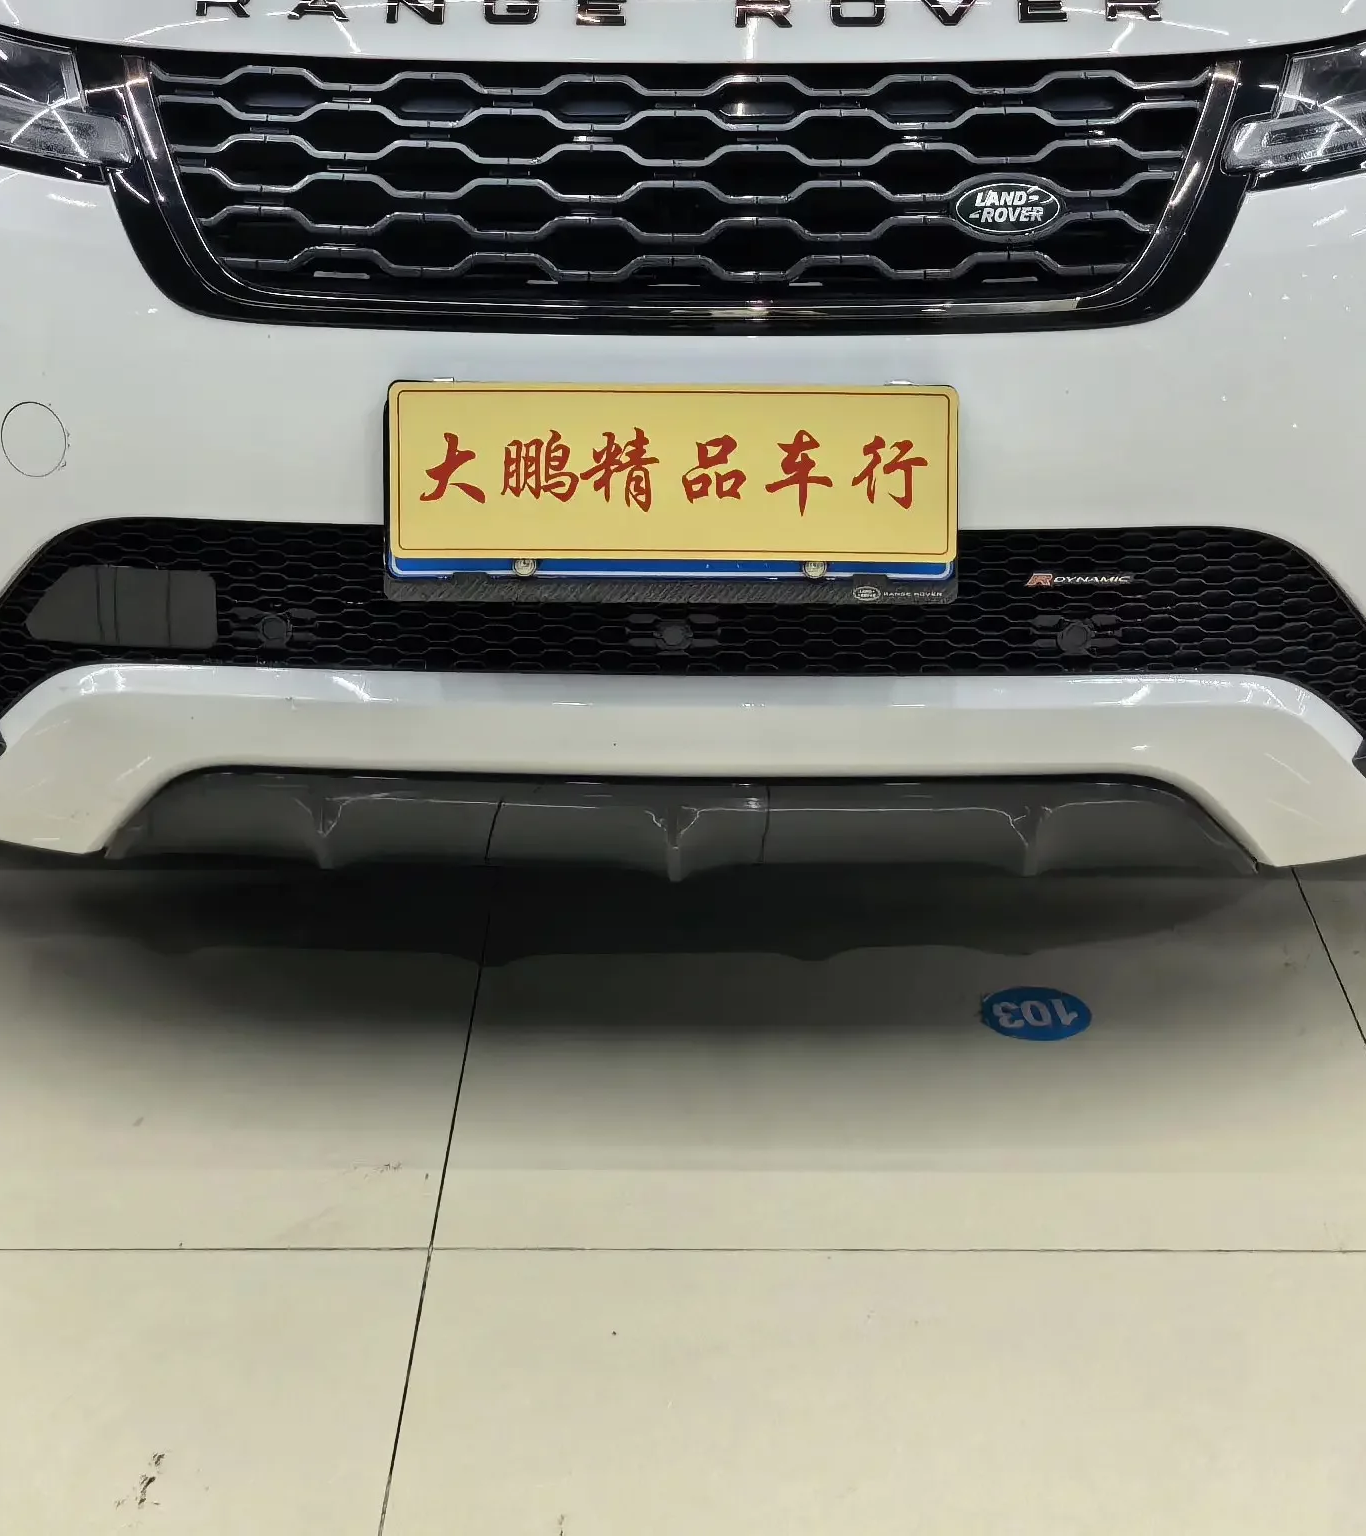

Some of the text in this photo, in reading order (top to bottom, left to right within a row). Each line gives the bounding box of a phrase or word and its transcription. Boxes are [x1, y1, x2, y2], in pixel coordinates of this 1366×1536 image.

[975, 190, 1027, 206] LAND
[980, 207, 1044, 223] ROVER
[420, 427, 928, 516] 大鹏精品车行
[1053, 574, 1131, 584] DYNAMIC
[992, 998, 1079, 1028] 103
